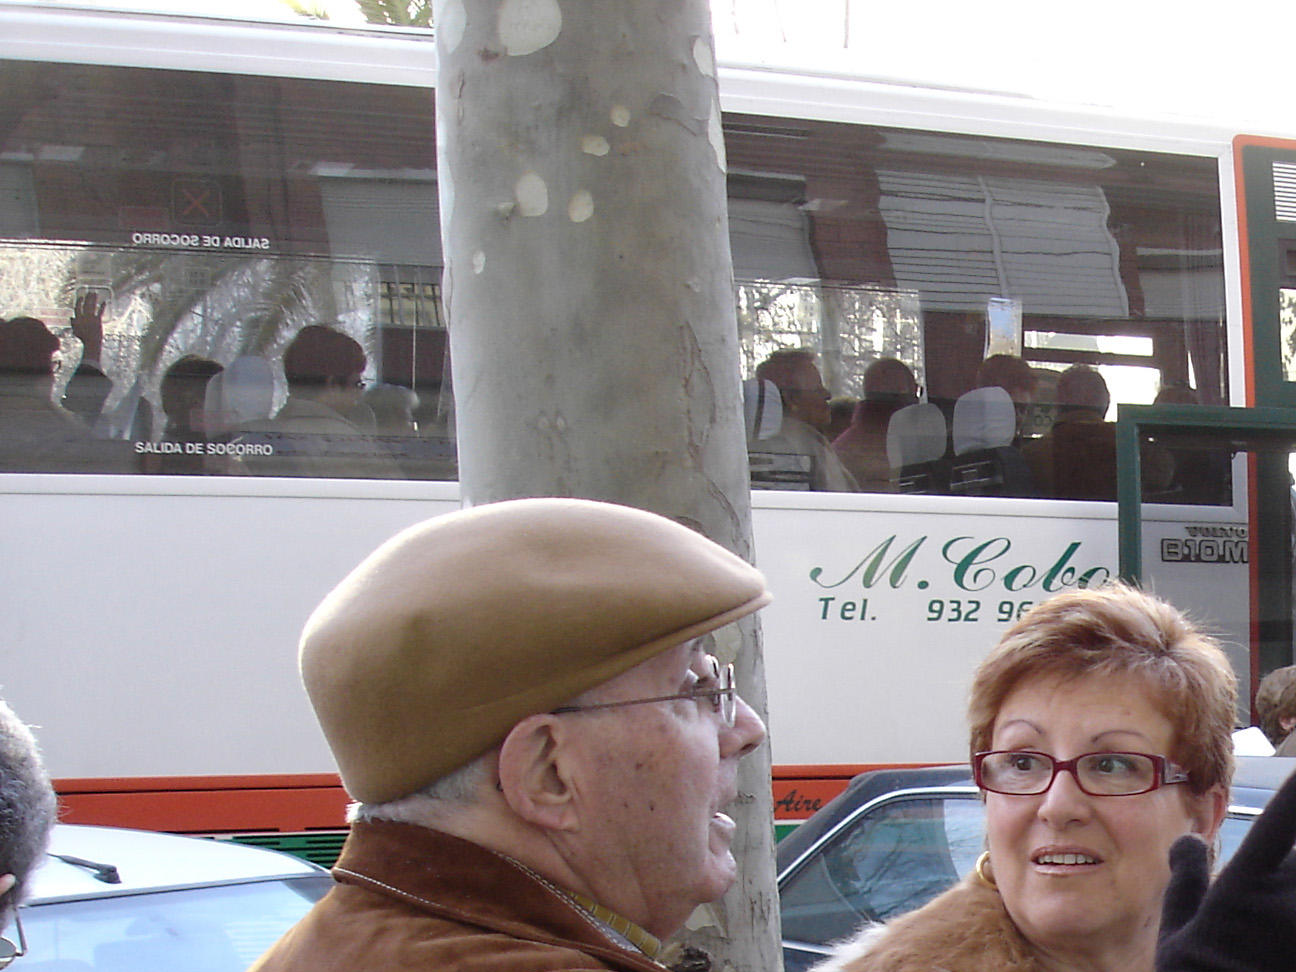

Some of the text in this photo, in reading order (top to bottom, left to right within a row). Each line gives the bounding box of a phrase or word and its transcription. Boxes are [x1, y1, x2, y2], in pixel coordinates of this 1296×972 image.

[135, 441, 273, 456] SALIDA DE SOCORRO
[809, 534, 1111, 592] M. Cobo
[818, 597, 877, 621] Tel.
[927, 599, 982, 622] 932
